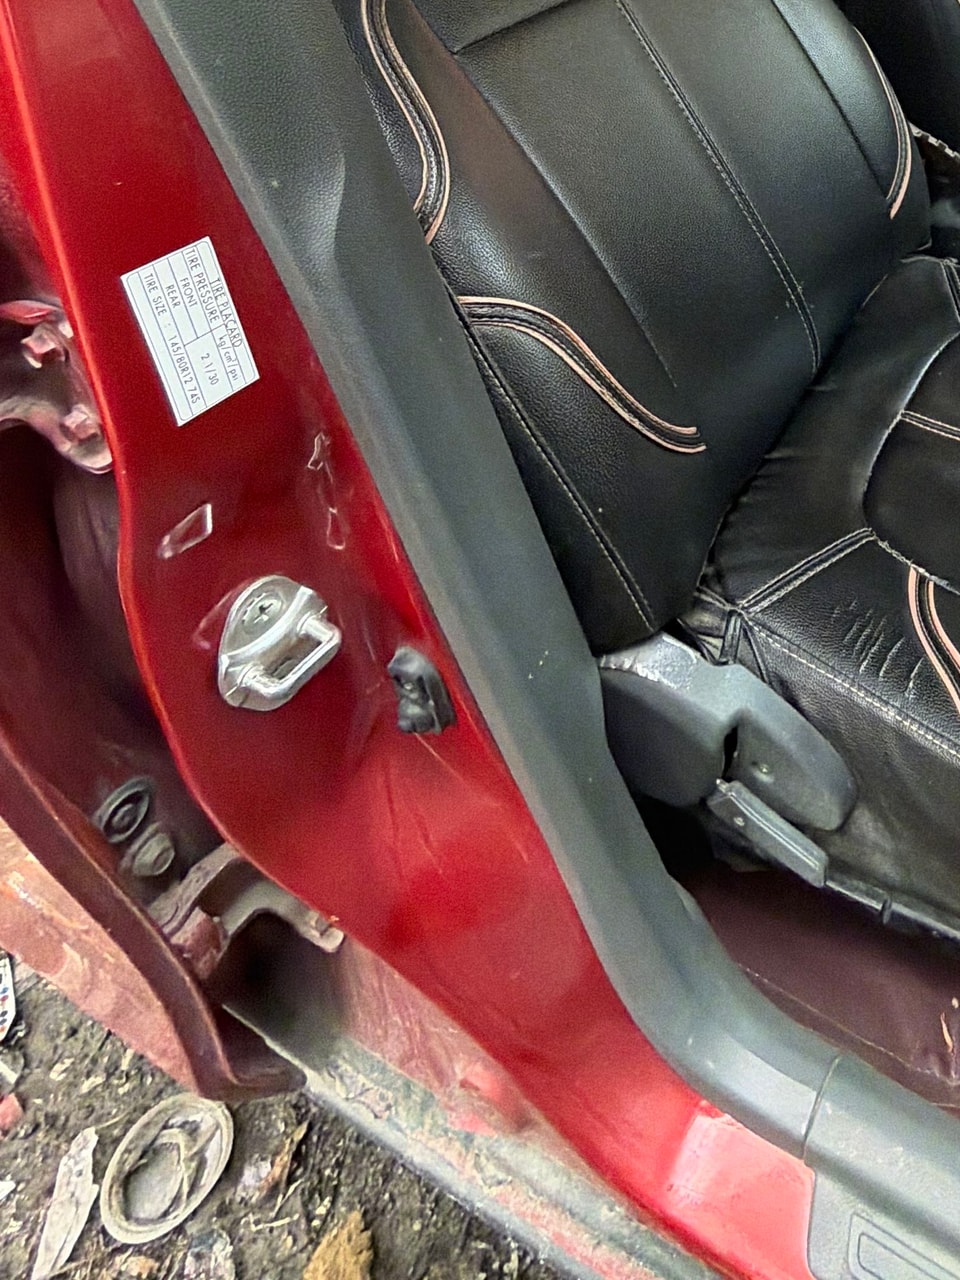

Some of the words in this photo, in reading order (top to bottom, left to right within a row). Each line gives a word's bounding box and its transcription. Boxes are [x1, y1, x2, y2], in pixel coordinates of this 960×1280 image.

[143, 272, 159, 294] TIRE
[152, 295, 168, 317] SIZE
[165, 284, 181, 309] REAR
[180, 277, 199, 308] FRONT
[185, 247, 201, 272] TIRE
[194, 272, 221, 324] PRESSURE
[209, 277, 227, 301] TIRE
[218, 301, 244, 349] PLACARD
